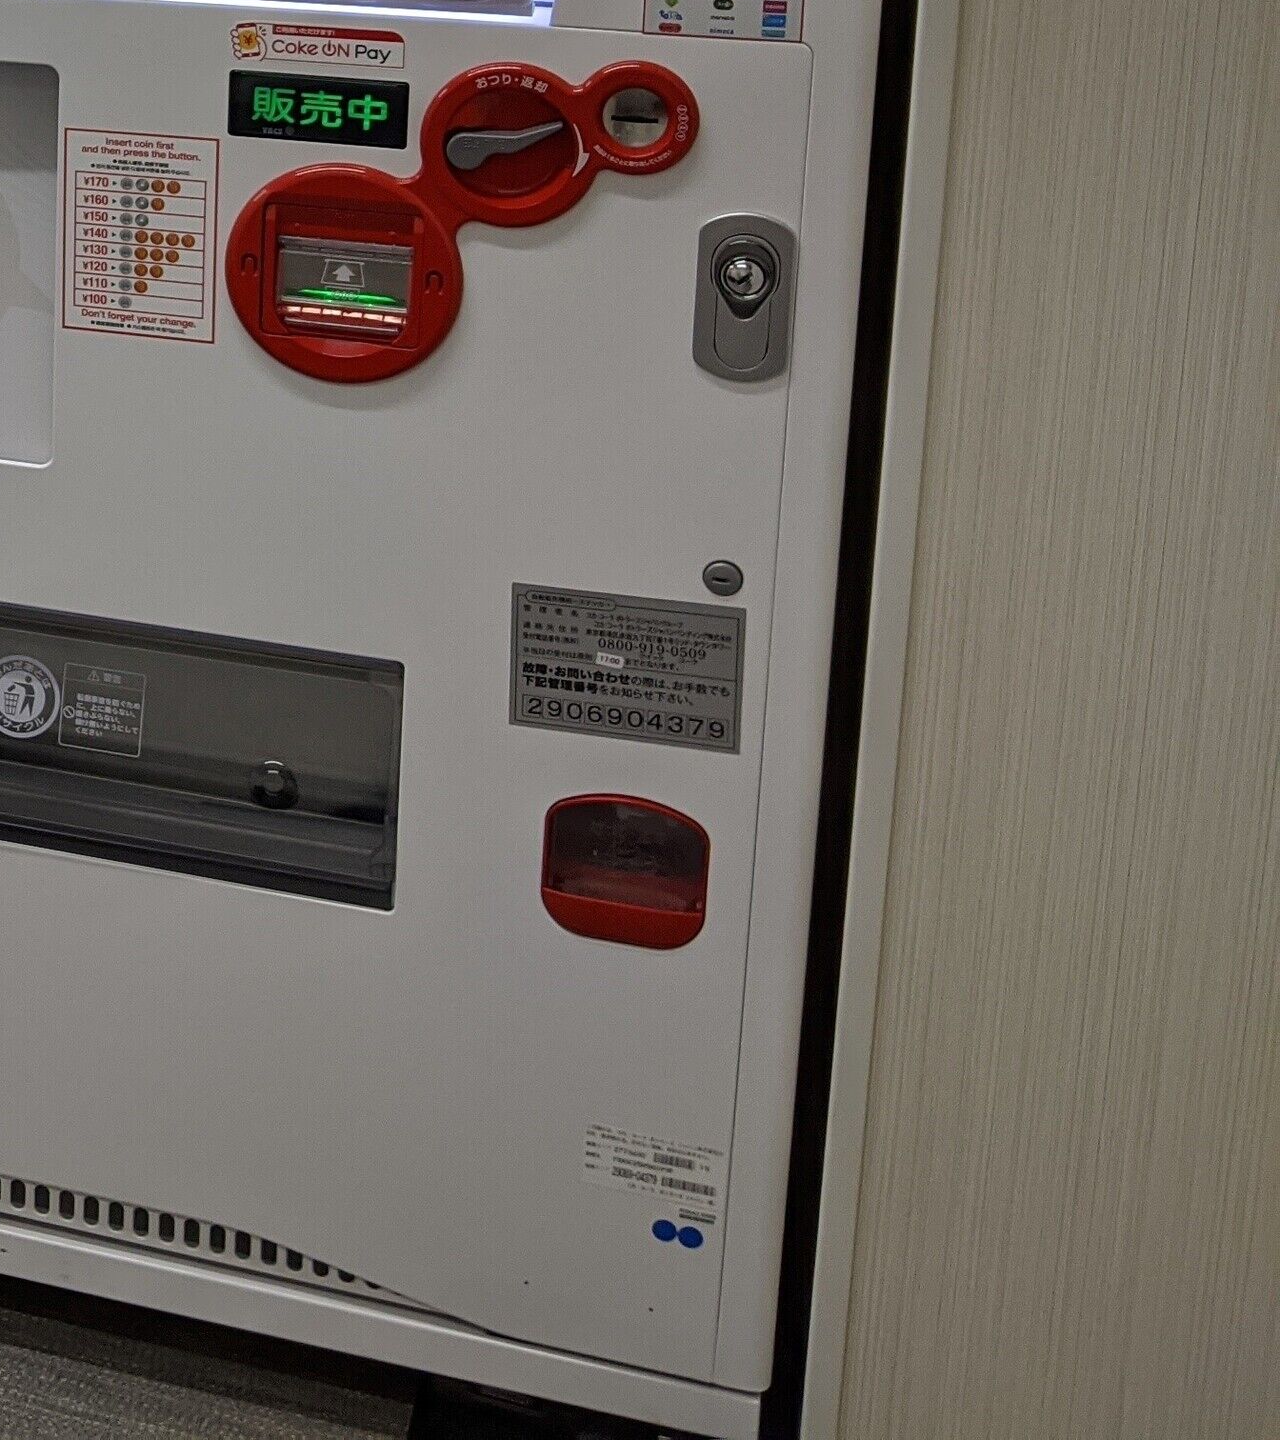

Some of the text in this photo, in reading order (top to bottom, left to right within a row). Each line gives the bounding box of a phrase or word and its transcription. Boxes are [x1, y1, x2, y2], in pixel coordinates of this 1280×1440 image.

[272, 40, 391, 64] Coke ON Pay
[252, 87, 388, 131] 販売中
[105, 137, 174, 150] Insert coin first
[82, 146, 98, 154] and
[101, 147, 121, 156] then
[123, 149, 149, 158] press
[151, 150, 167, 159] the
[83, 176, 109, 187] ¥170
[83, 228, 109, 239] ¥140
[83, 260, 109, 271] ¥120
[83, 294, 109, 305] ¥100
[107, 311, 134, 323] forget
[137, 315, 158, 325] your
[527, 697, 726, 739] 2906904379
